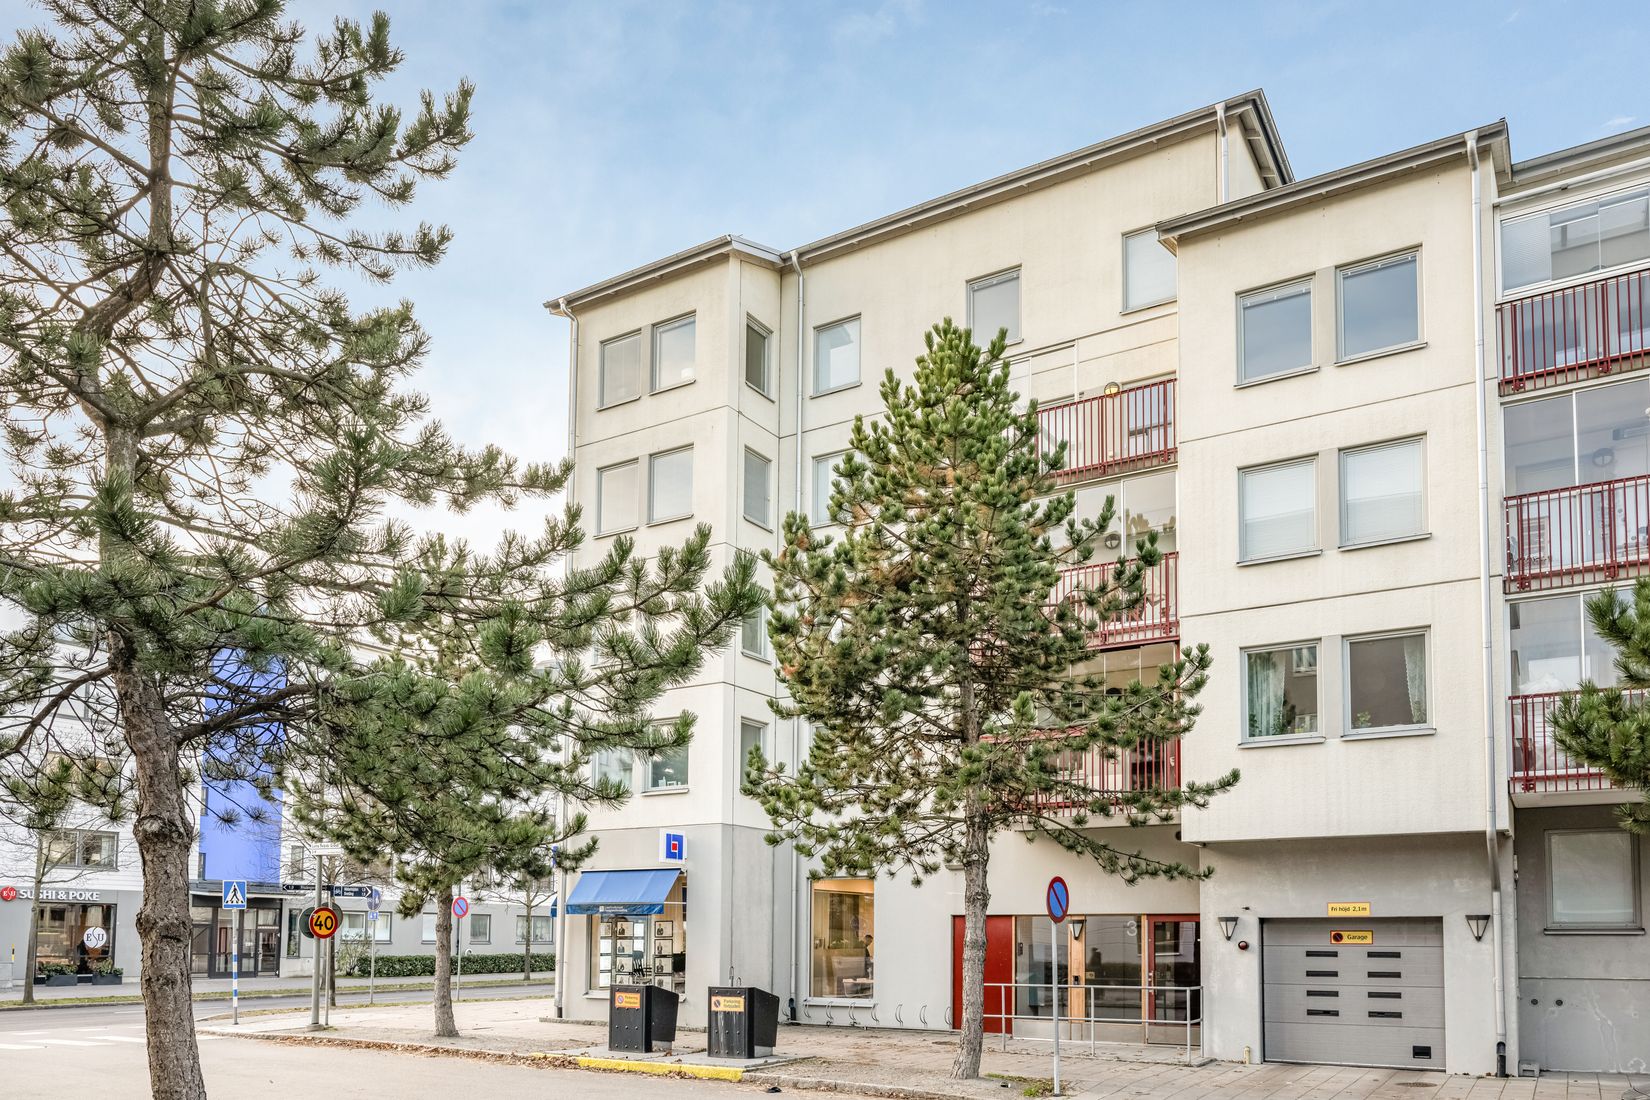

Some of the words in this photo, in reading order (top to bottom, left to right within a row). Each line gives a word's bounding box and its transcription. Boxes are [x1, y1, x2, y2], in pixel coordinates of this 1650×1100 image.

[58, 890, 66, 900] &
[69, 891, 100, 901] POKE
[314, 916, 334, 930] 40
[1126, 920, 1138, 936] 3
